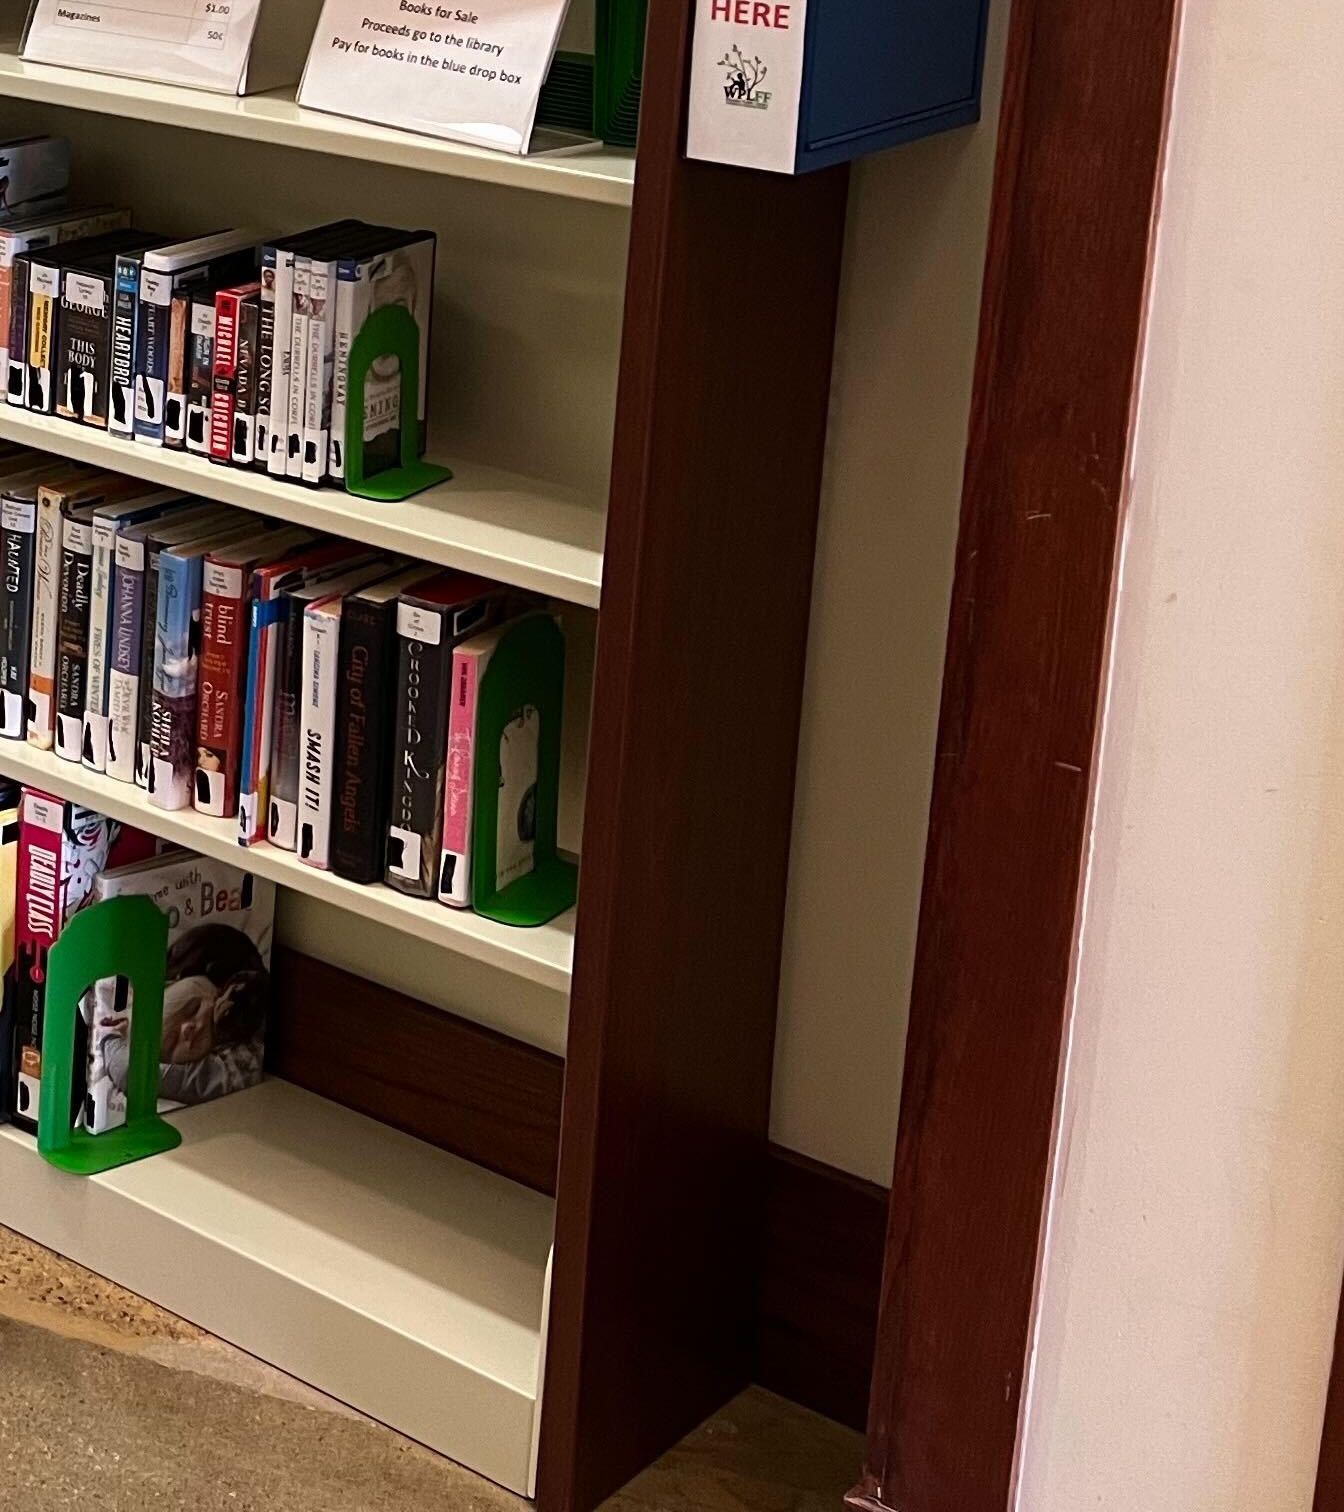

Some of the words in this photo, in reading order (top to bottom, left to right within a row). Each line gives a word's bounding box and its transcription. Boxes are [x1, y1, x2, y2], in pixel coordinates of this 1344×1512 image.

[58, 9, 100, 23] Magazines
[206, 3, 230, 15] $1.00
[399, 0, 432, 18] Books
[435, 6, 452, 20] for
[455, 9, 478, 24] Sale
[362, 18, 410, 38] Proceeds
[412, 29, 427, 42] go
[430, 31, 441, 43] to
[445, 33, 463, 47] the
[466, 37, 504, 57] library
[332, 37, 352, 53] Pay
[354, 41, 369, 56] for
[371, 45, 404, 62] books
[407, 51, 417, 63] in
[421, 53, 438, 68] the
[441, 58, 466, 74] blue
[469, 63, 496, 83] drop
[499, 69, 522, 84] box
[724, 87, 772, 104] WPLFF
[217, 315, 233, 366] MICHAEL
[261, 307, 273, 339] THE
[294, 317, 302, 333] THE
[312, 323, 320, 341] THE
[68, 351, 97, 368] BODY
[71, 337, 96, 355] THIS
[258, 345, 273, 392] LONG
[336, 332, 348, 407] HEMINGWAY
[212, 393, 231, 450] CRICHTON
[5, 534, 21, 593] HAUNTED
[60, 551, 75, 612] Devotion
[72, 563, 90, 612] Deadly
[120, 571, 137, 624] JOHANNA
[203, 602, 213, 639] trust
[216, 605, 233, 645] blind
[92, 627, 103, 656] FIRES
[116, 627, 134, 673] LINDSEY
[69, 663, 81, 707] SANDRA
[92, 659, 102, 674] OF
[345, 645, 368, 685] City
[89, 677, 101, 714] WINTER
[200, 681, 213, 741] ORCHARD
[212, 690, 229, 738] SANDRA
[349, 688, 365, 707] of
[407, 642, 424, 746] CROOKED
[305, 729, 322, 782] SMASH
[346, 713, 365, 767] Fallen
[305, 788, 320, 811] IT!
[340, 770, 360, 833] Angels
[28, 844, 57, 896] DEADLY
[27, 897, 51, 938] CLASS
